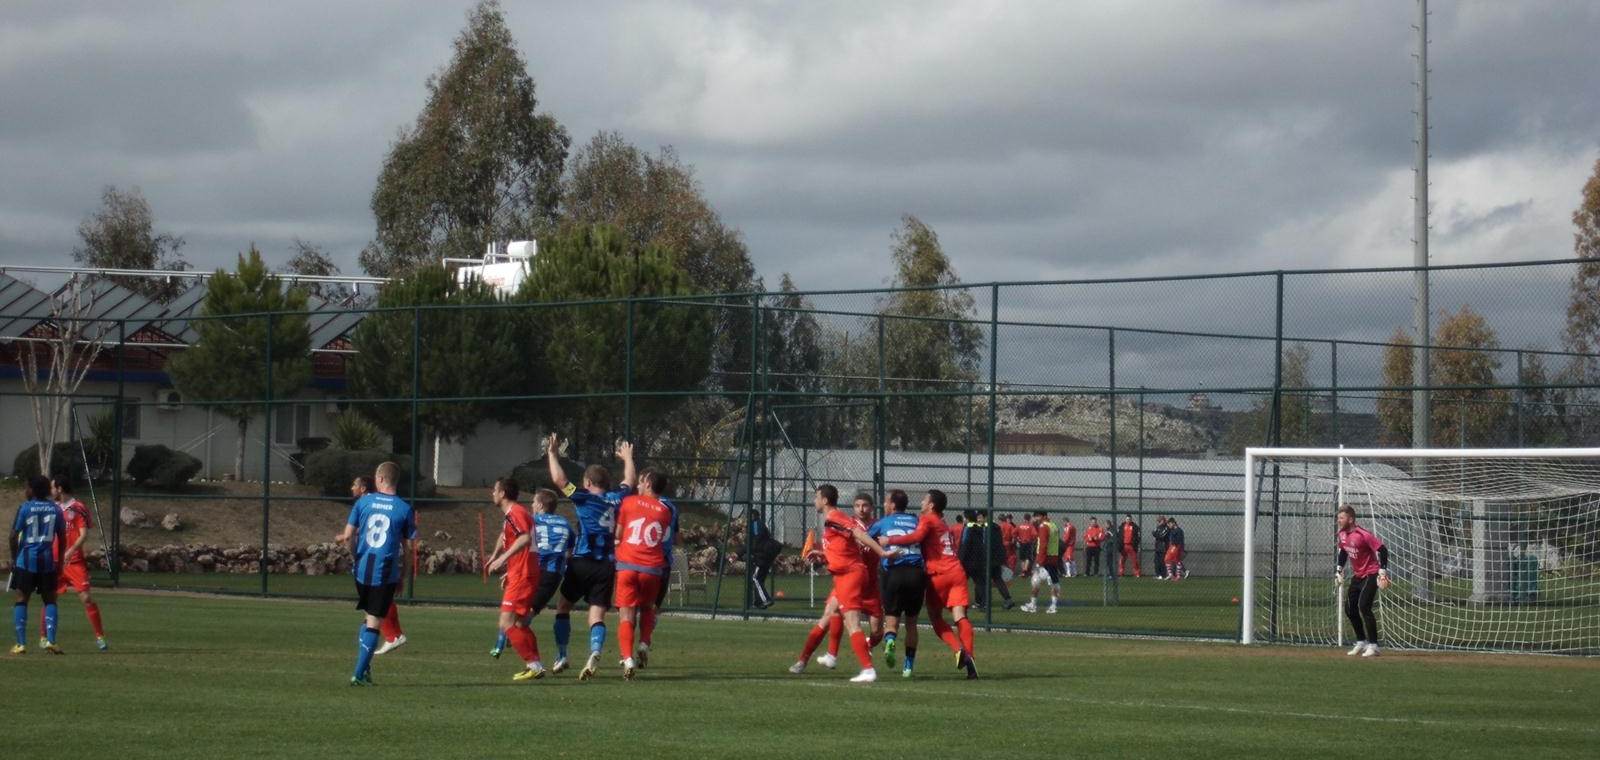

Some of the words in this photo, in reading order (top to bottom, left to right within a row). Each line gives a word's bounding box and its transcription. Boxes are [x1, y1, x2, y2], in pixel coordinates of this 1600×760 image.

[26, 514, 56, 543] 11
[366, 514, 390, 548] 8
[536, 525, 569, 552] 17
[627, 517, 662, 547] 10
